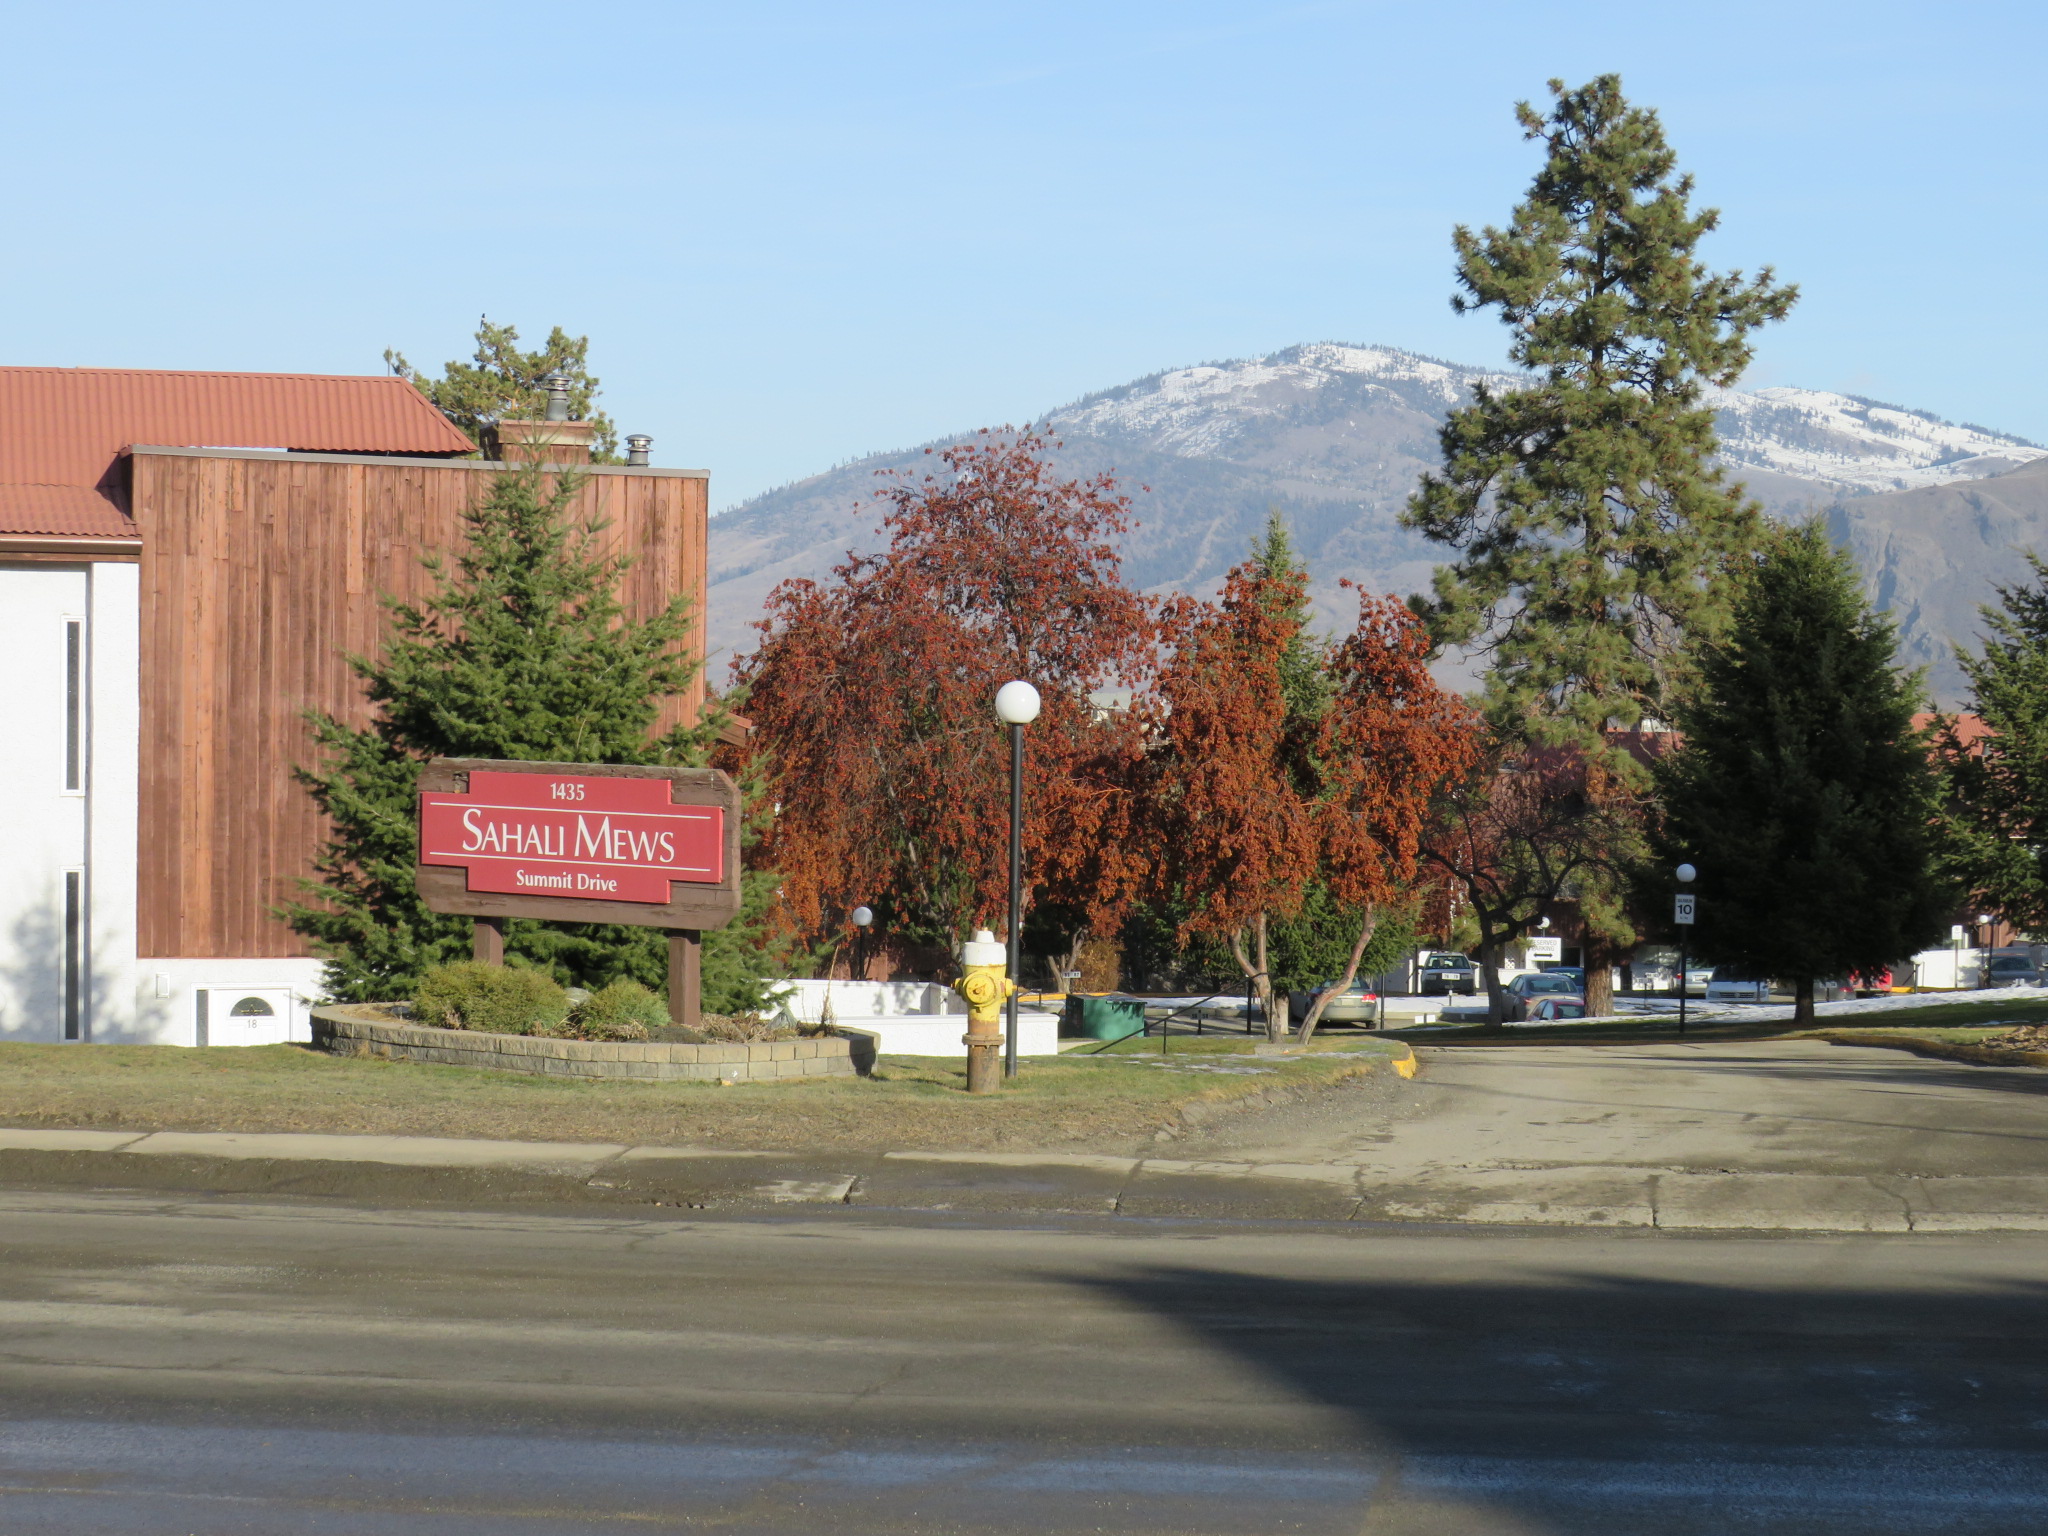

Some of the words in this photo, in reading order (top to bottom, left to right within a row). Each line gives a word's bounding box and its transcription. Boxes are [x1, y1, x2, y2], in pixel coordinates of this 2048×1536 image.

[550, 782, 585, 801] 1435
[462, 808, 565, 856] SAHALI
[574, 814, 675, 863] MEWS
[516, 869, 573, 889] Summit
[577, 873, 617, 892] Drive
[1677, 904, 1693, 915] 10
[247, 1019, 258, 1029] 18
